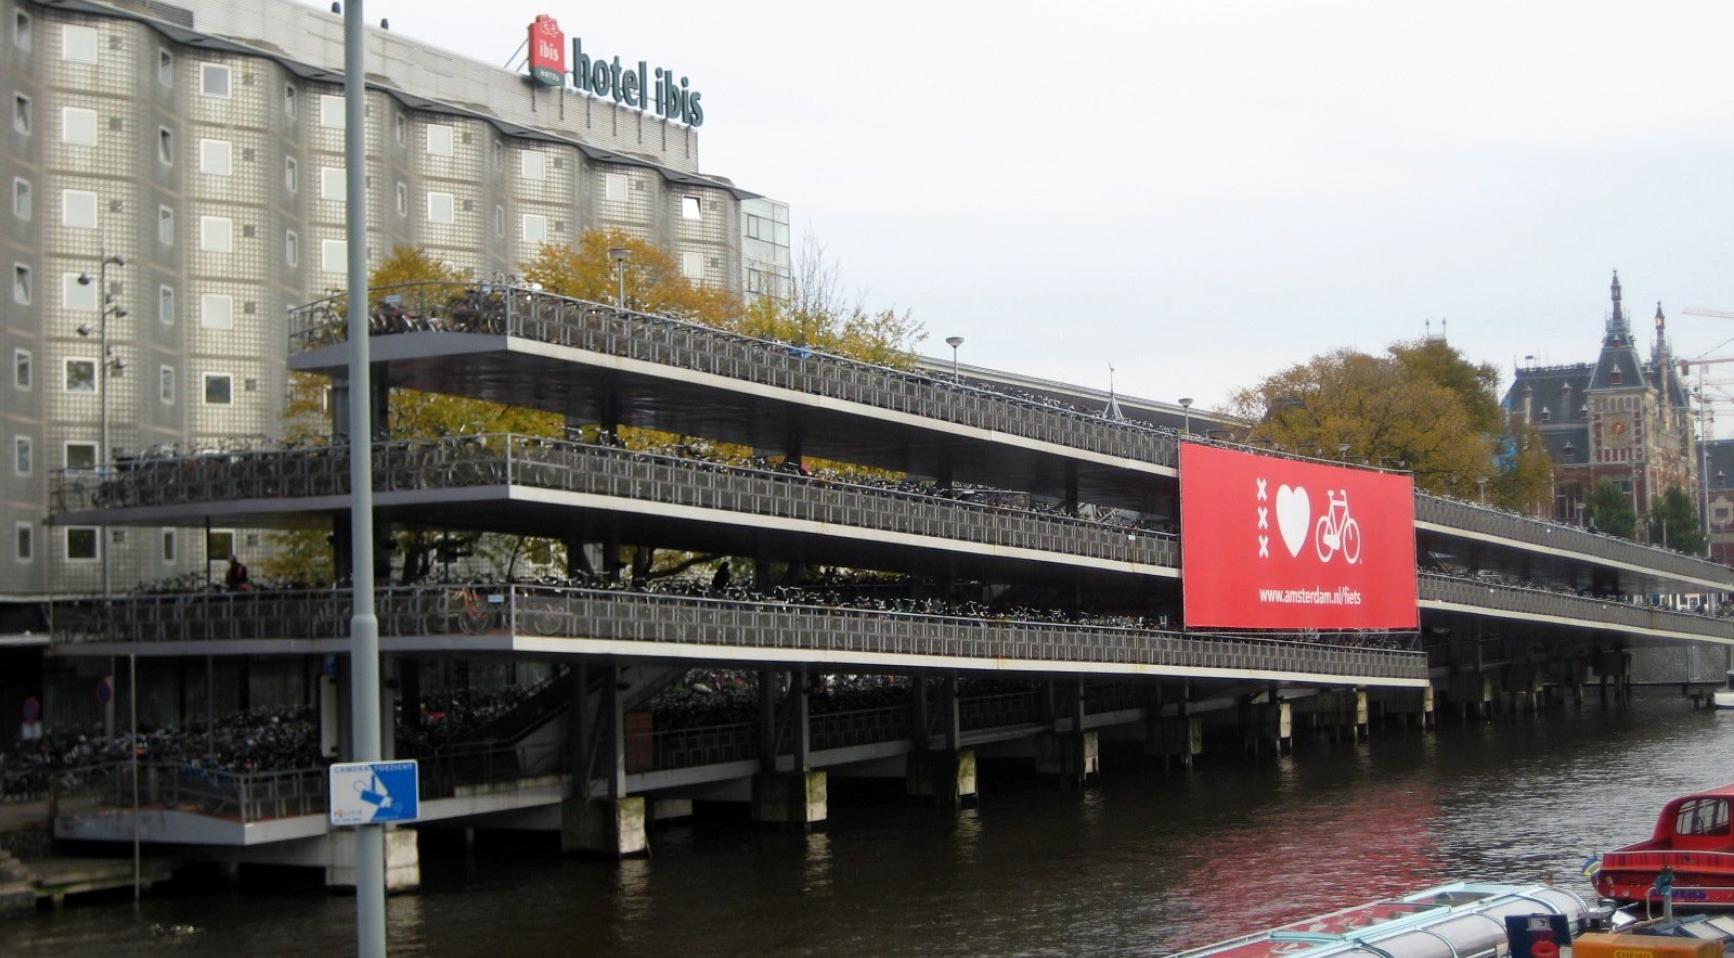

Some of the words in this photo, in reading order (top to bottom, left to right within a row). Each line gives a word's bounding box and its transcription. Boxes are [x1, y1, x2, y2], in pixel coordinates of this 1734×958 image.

[539, 40, 560, 62] ibis
[572, 37, 647, 110] hotel
[655, 66, 704, 128] ibis
[1259, 585, 1361, 606] www.amsterdam.nl/fiets
